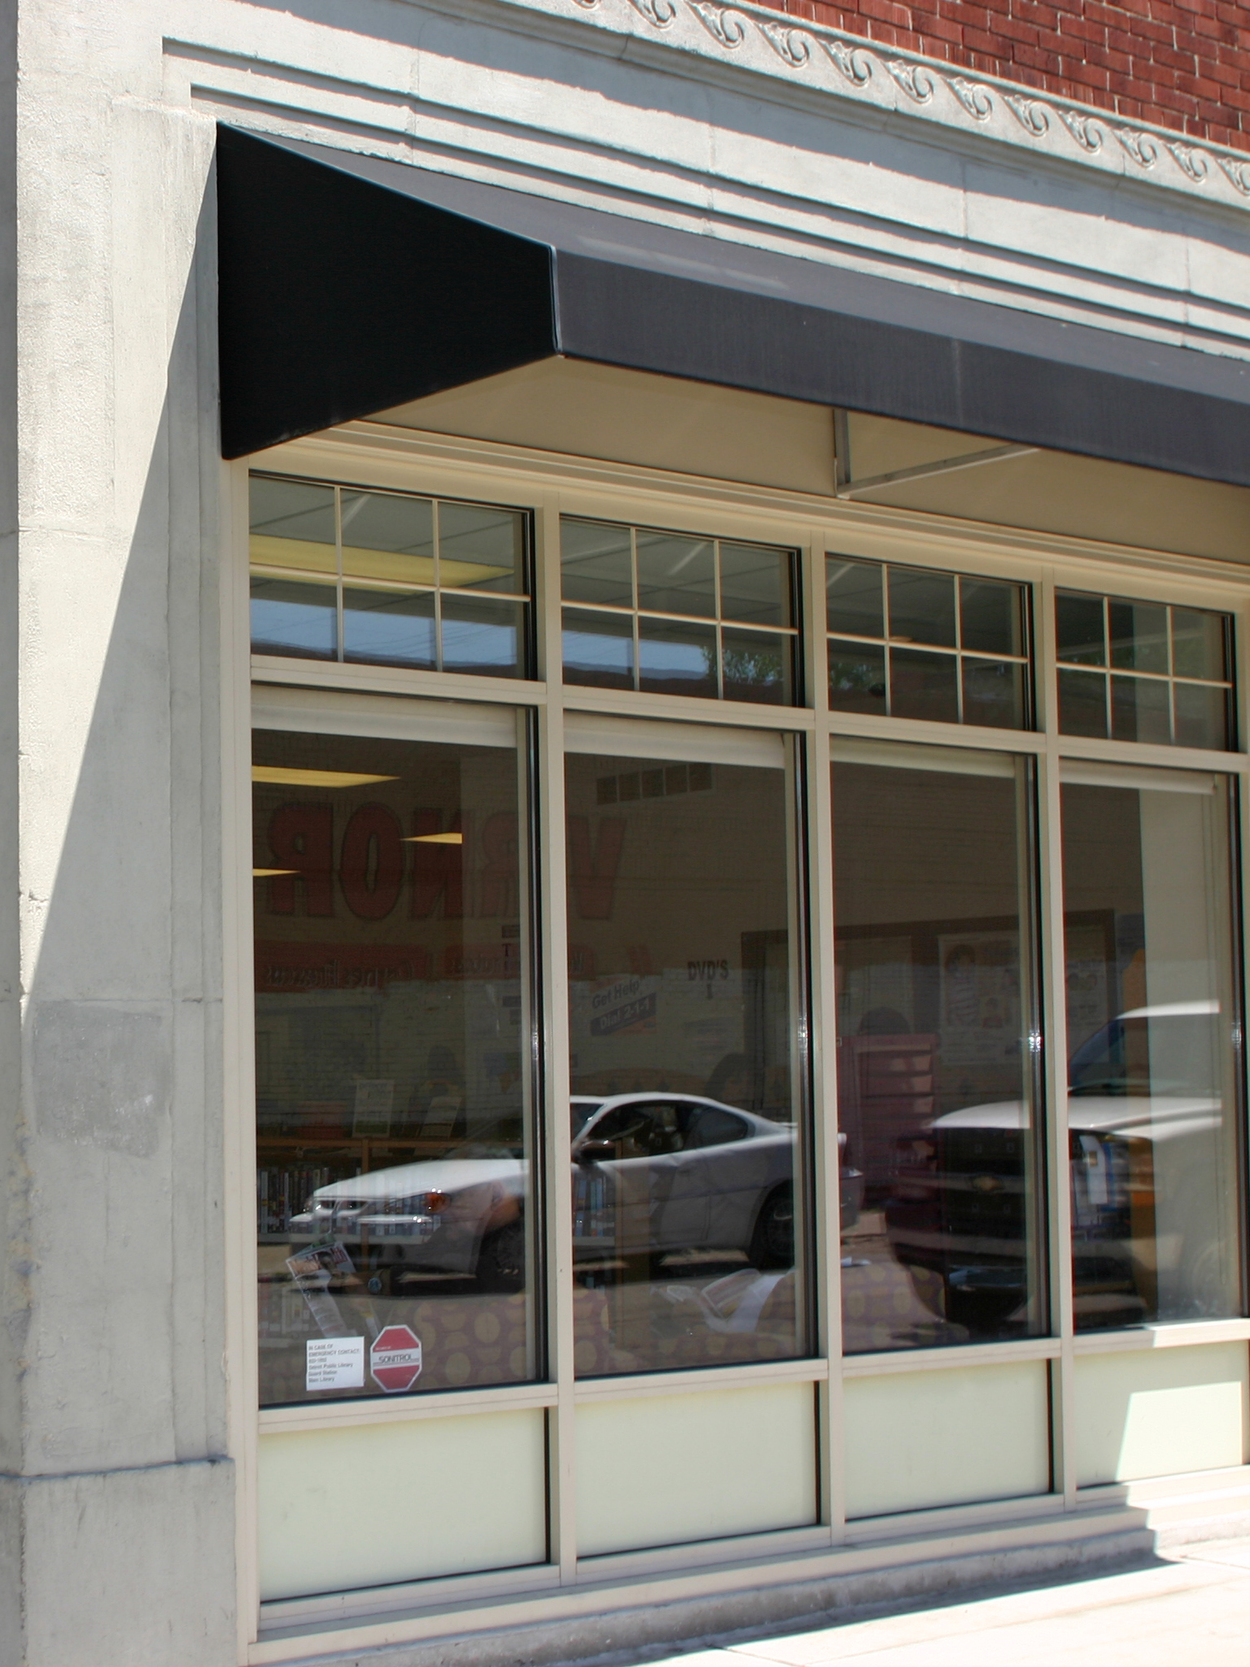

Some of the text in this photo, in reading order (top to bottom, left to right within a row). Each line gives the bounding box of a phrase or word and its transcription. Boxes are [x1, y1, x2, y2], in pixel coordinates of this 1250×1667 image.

[686, 959, 729, 981] DVD'S
[592, 979, 640, 1009] Get Help
[378, 1353, 412, 1364] SONITROL
